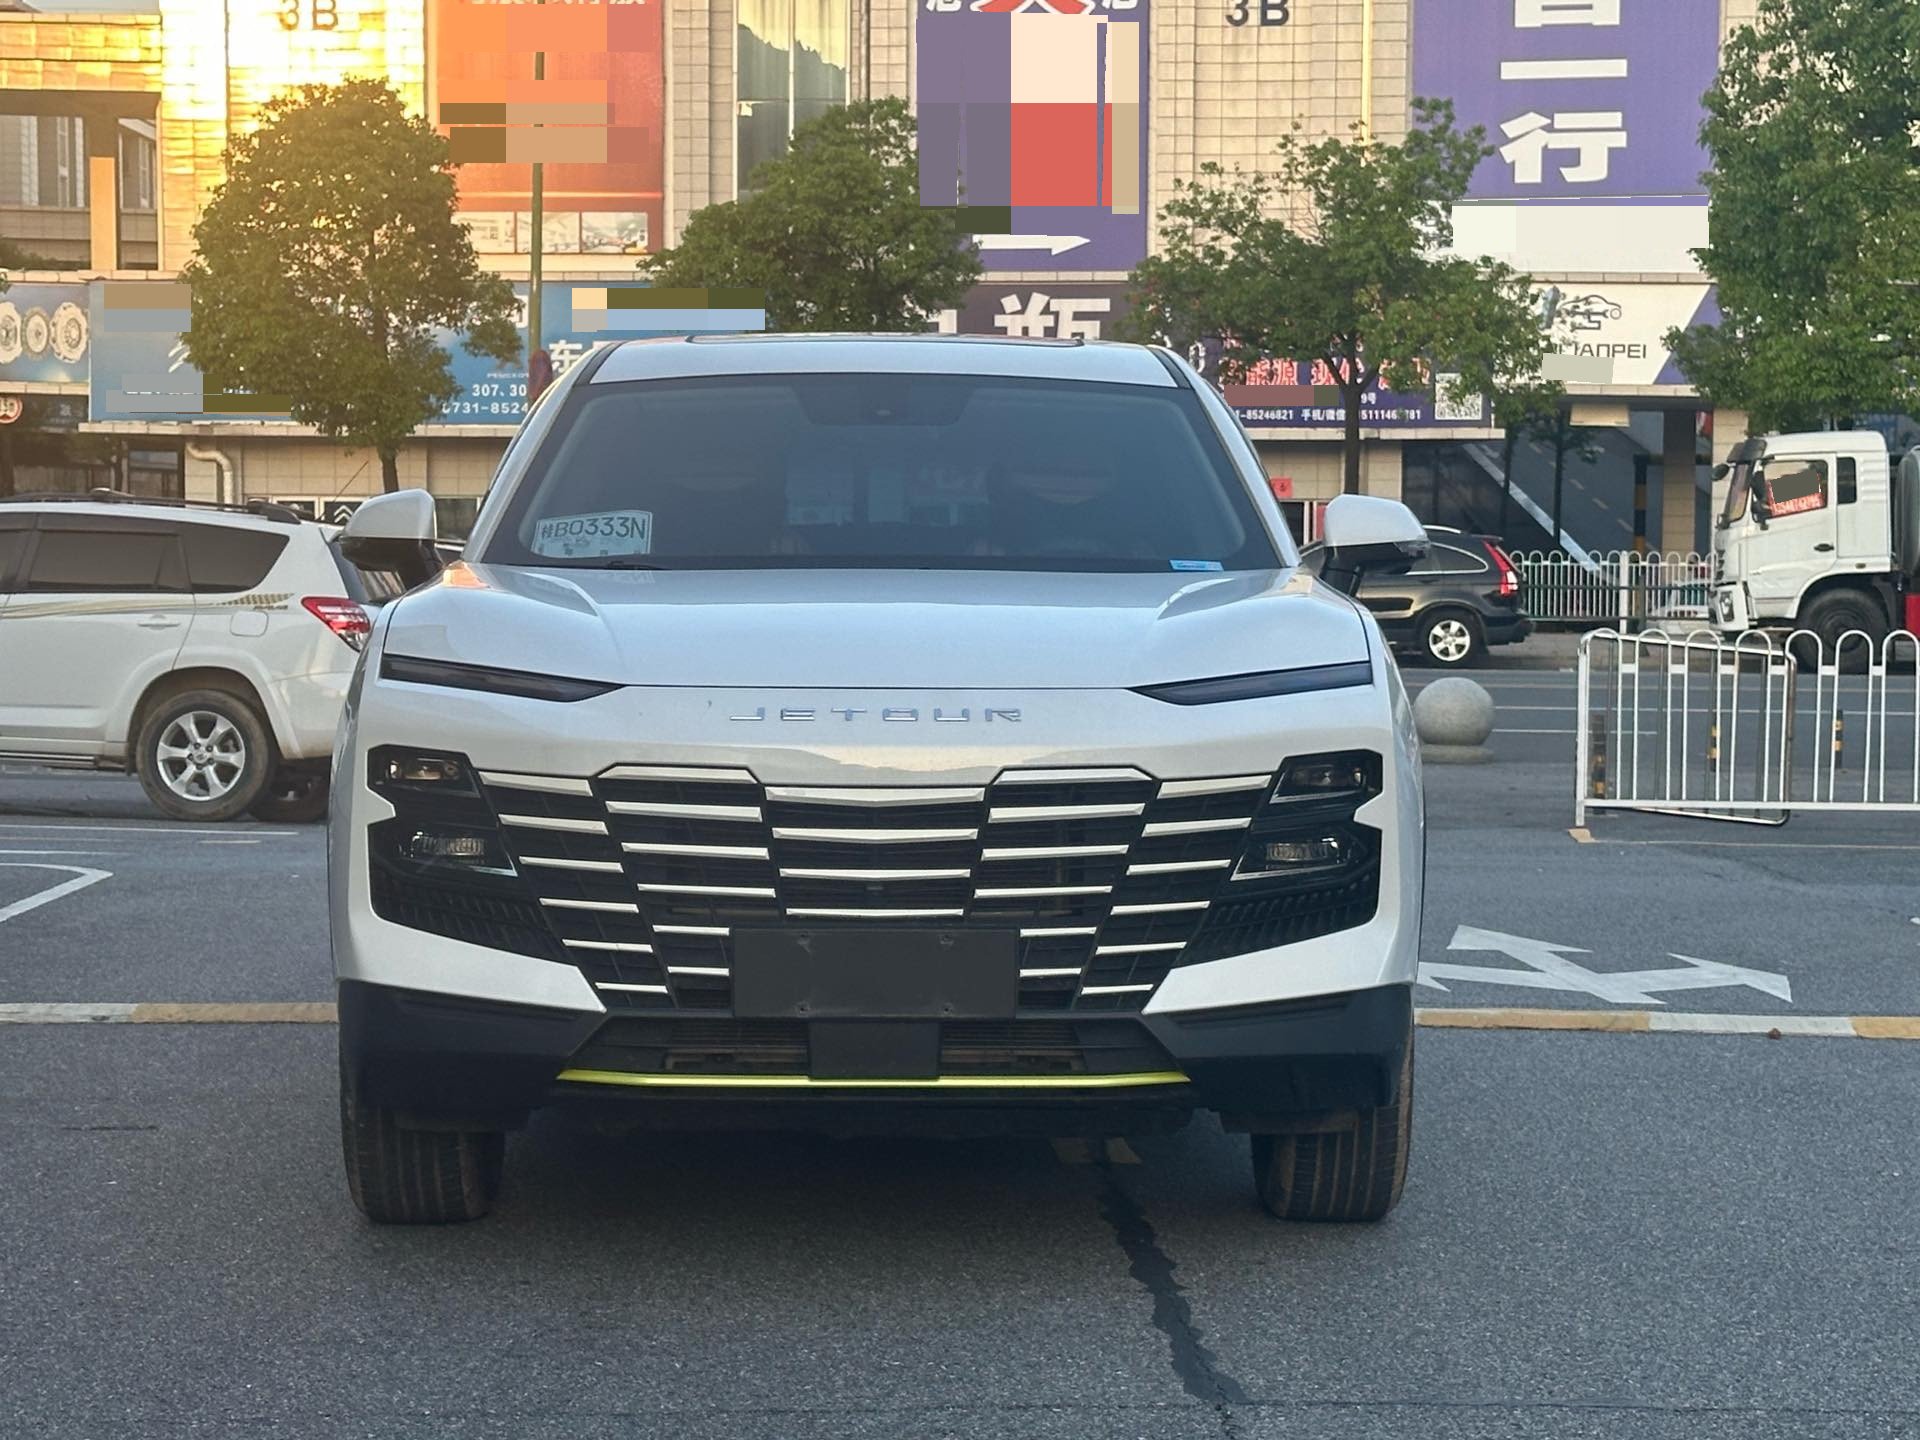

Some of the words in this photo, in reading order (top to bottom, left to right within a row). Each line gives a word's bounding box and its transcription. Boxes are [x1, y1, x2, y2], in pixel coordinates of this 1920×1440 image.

[1225, 0, 1290, 27] 3B
[1499, 0, 1628, 183] 一行
[730, 706, 1022, 722] JETOUR
